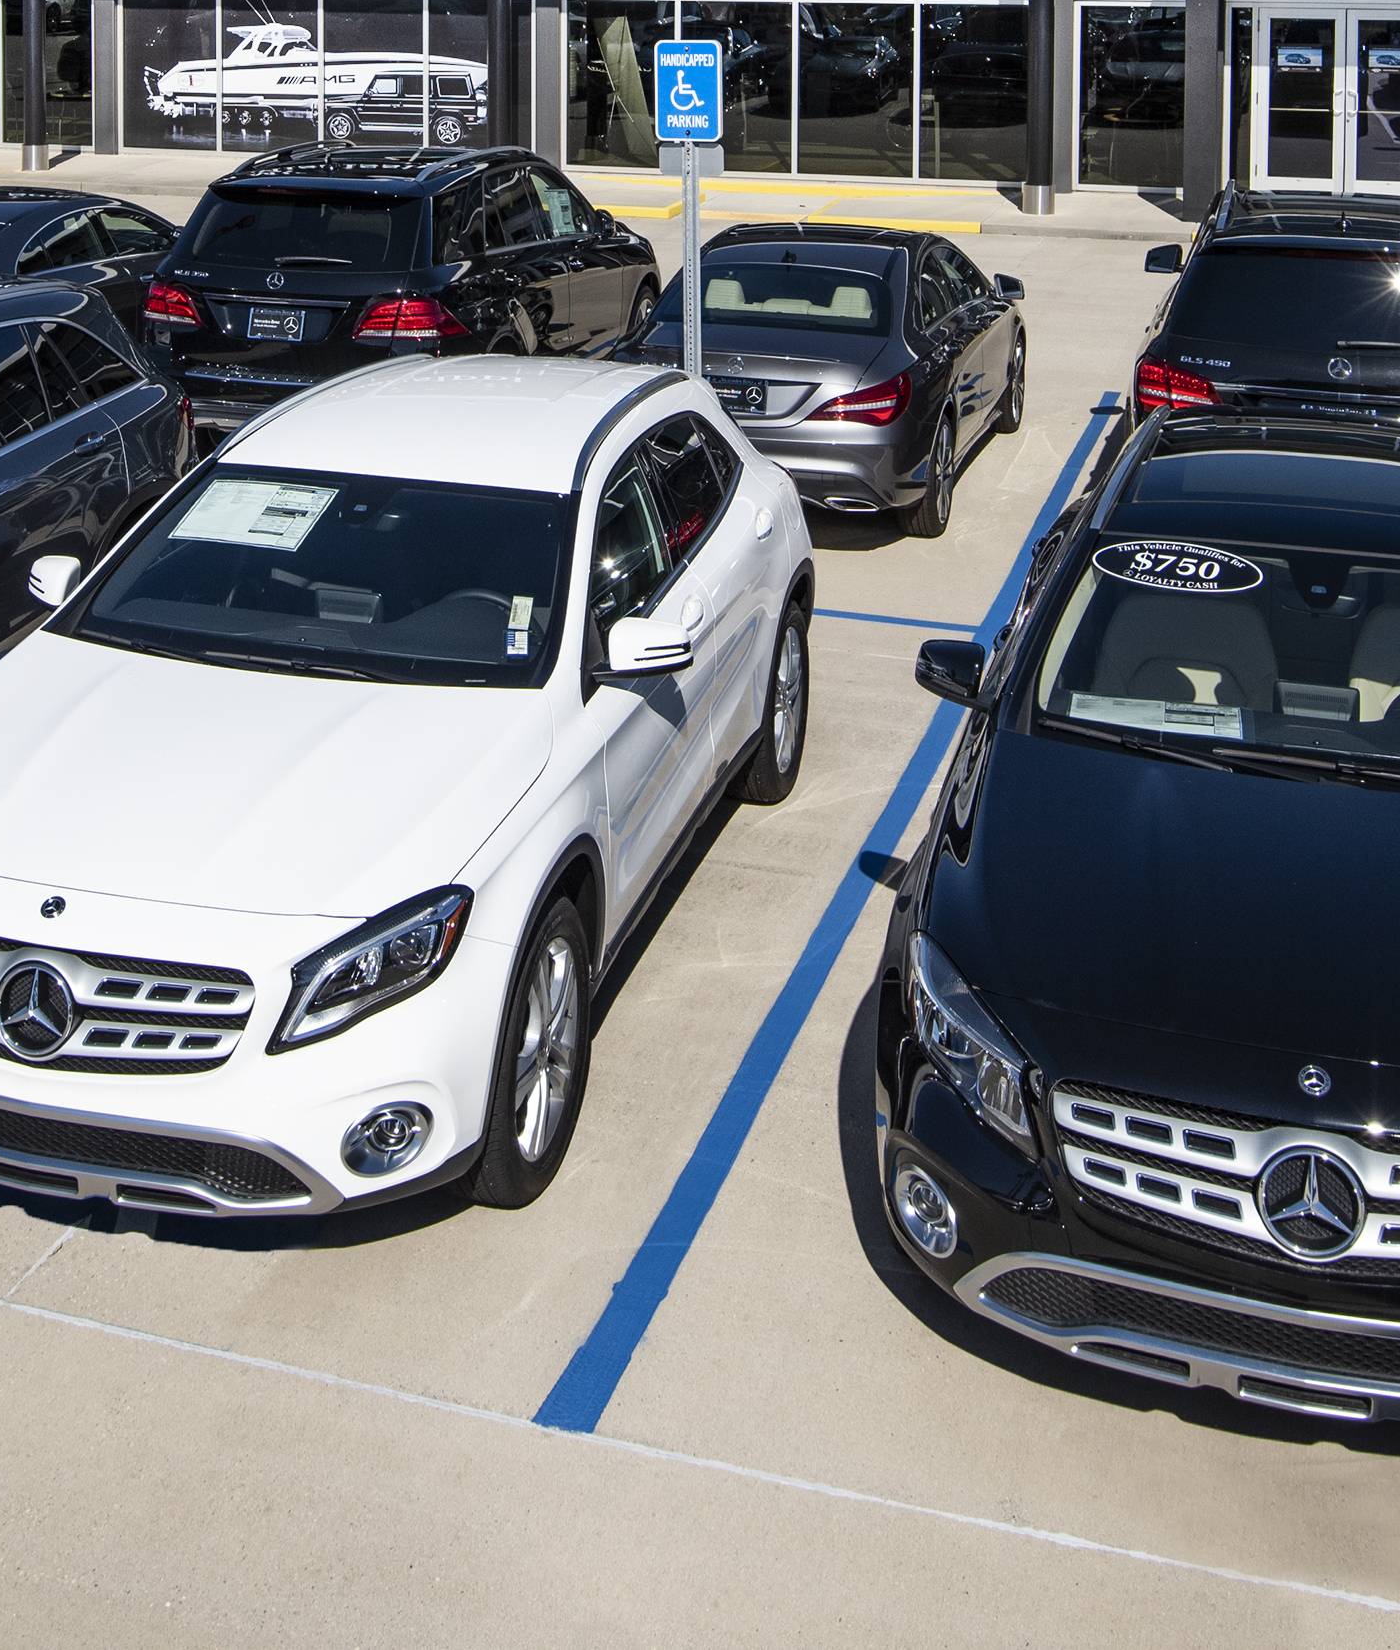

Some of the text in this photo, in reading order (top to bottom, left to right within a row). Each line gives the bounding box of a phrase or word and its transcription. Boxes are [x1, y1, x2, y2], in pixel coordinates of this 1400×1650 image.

[660, 53, 715, 67] HANDICAPPED
[667, 114, 709, 128] PARKING
[1180, 355, 1232, 368] GLS 450
[1117, 542, 1246, 569] This Vehicle Qualifies for
[1130, 550, 1221, 580] $750
[1134, 572, 1219, 589] LOYALTY CASH
